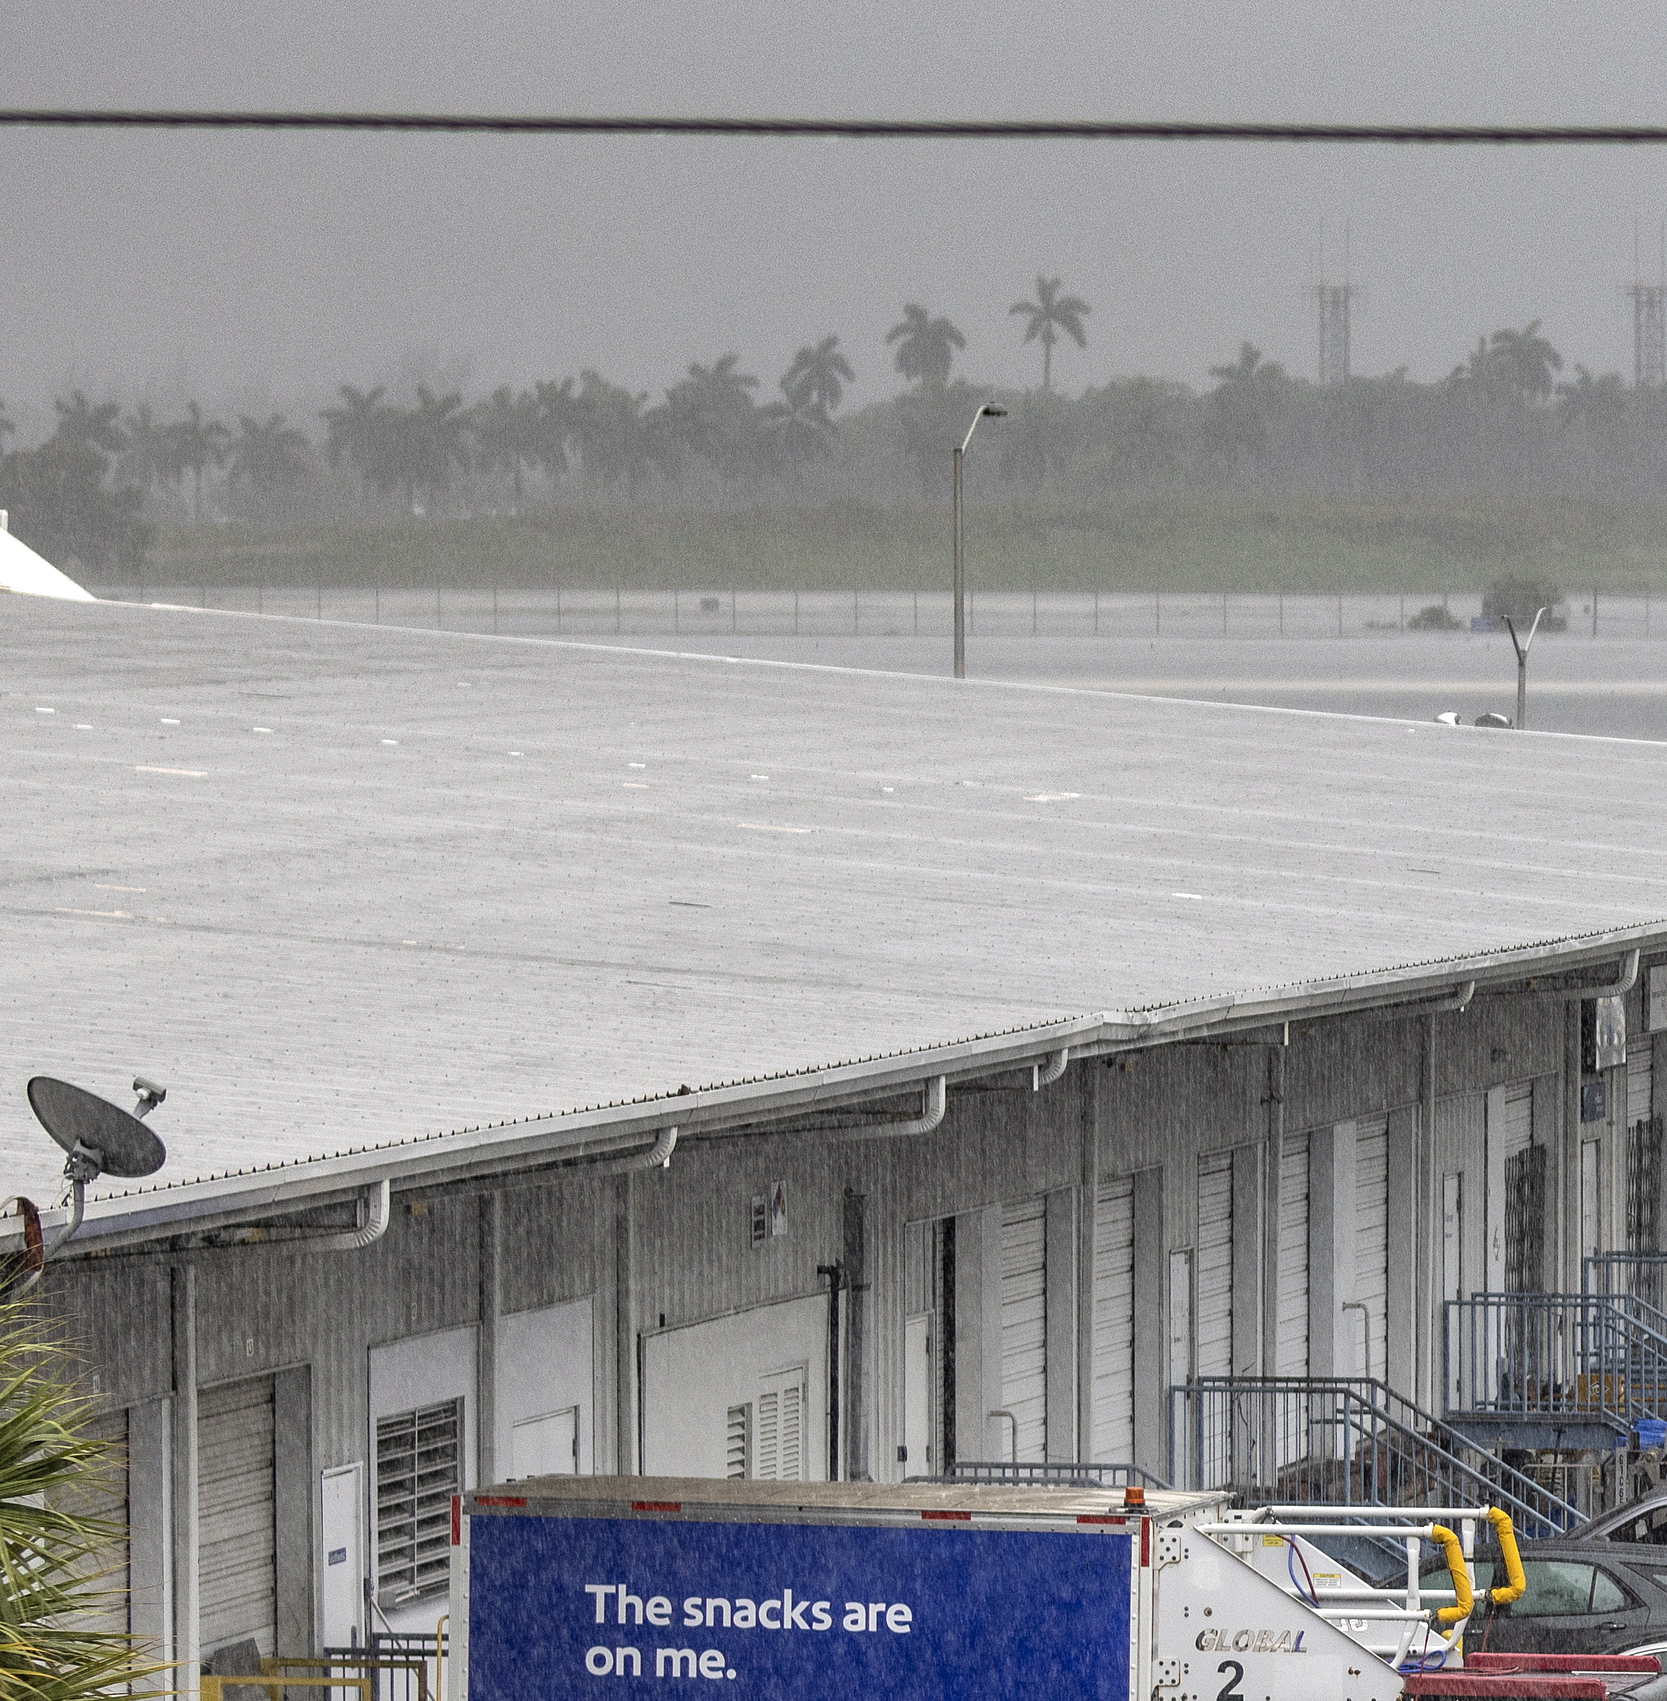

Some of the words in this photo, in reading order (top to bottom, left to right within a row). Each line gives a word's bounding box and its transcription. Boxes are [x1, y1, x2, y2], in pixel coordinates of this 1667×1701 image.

[584, 1583, 671, 1628] The
[683, 1589, 832, 1632] snacks
[842, 1600, 913, 1635] are
[1195, 1628, 1307, 1653] GLOBAL
[584, 1646, 645, 1679] on
[655, 1648, 737, 1681] me.
[1216, 1660, 1244, 1701] 2
